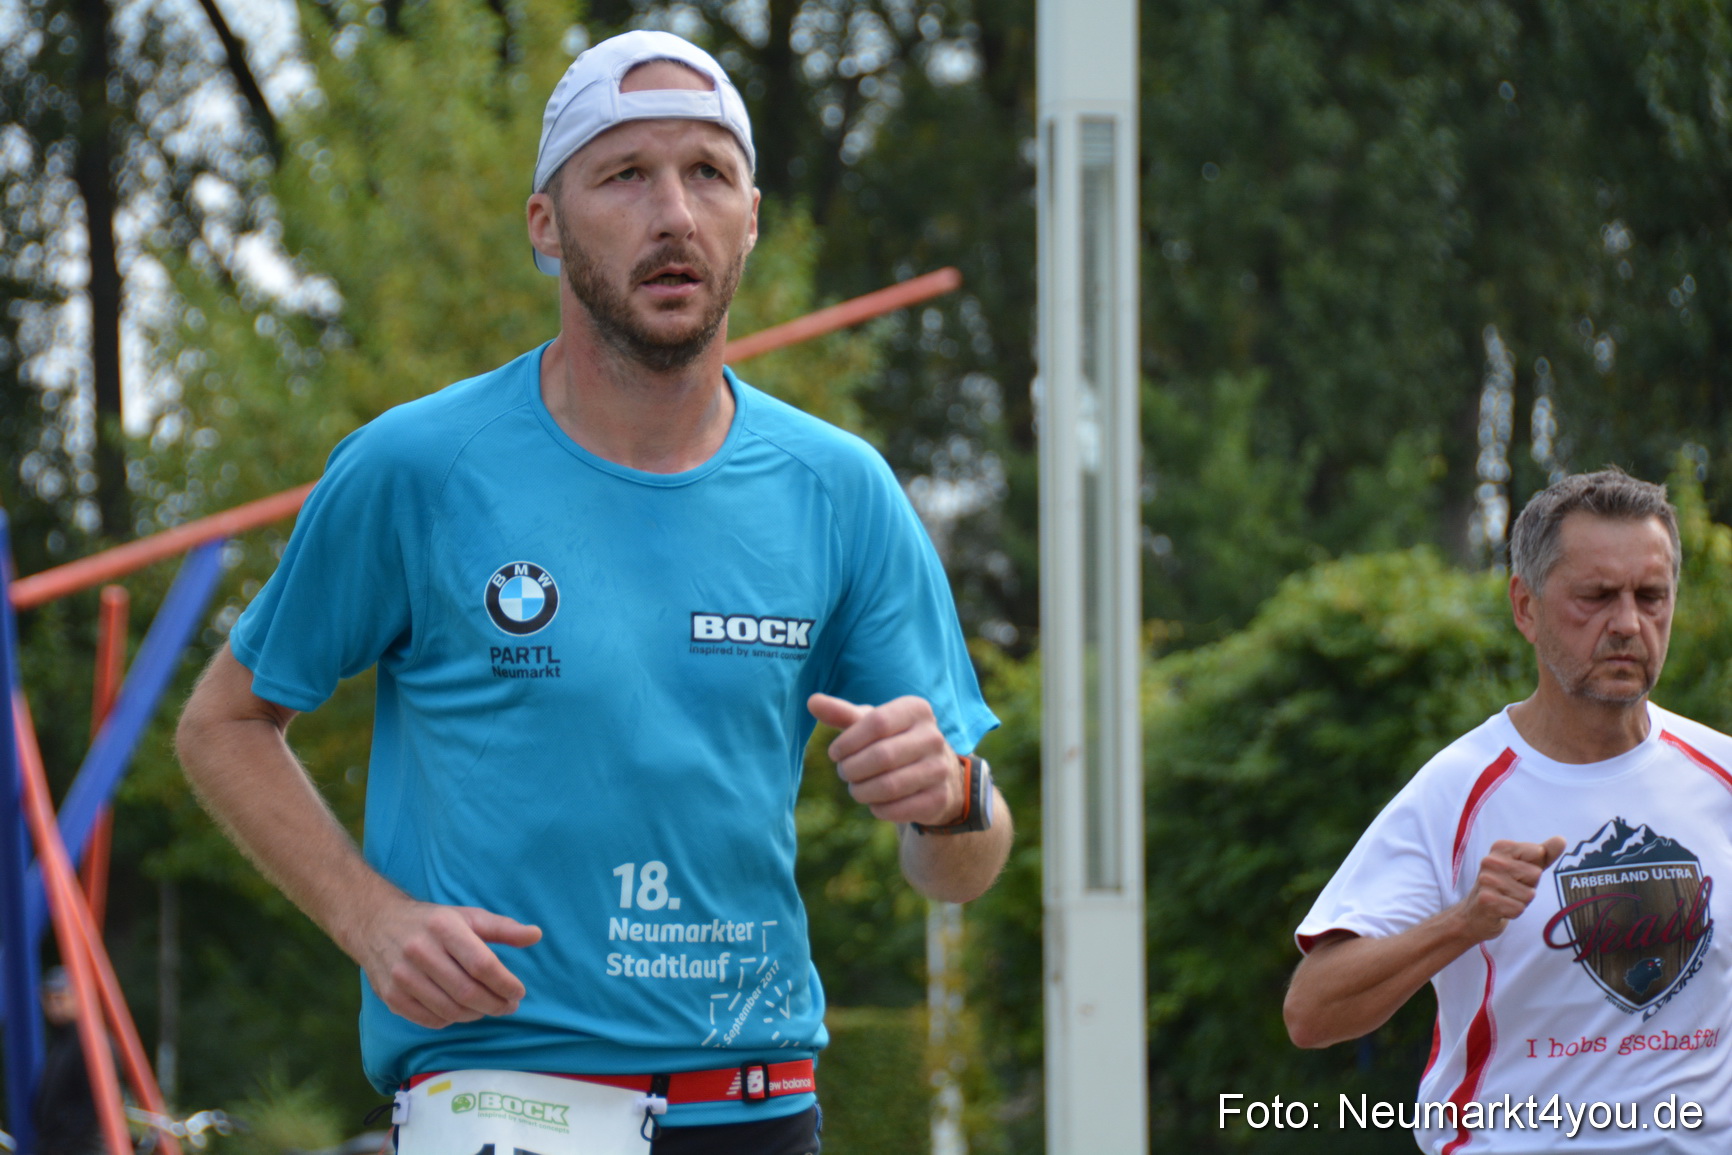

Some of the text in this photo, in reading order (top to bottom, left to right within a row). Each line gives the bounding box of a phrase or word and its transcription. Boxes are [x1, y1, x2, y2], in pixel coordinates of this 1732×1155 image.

[491, 564, 552, 589] BMW
[692, 612, 815, 648] BOCK
[490, 646, 561, 665] PARTL
[689, 645, 733, 656] inspired
[736, 646, 749, 657] by
[752, 649, 779, 658] smart
[492, 665, 561, 679] Neumarkt
[612, 861, 681, 911] 18.
[1570, 866, 1693, 889] ARBERLAND ULTRA
[608, 917, 755, 943] Neumarkter
[1543, 875, 1714, 963] Trail
[606, 952, 731, 983] Stadtlauf
[723, 959, 780, 1045] September 2017
[1526, 1039, 1538, 1058] I
[1547, 1036, 1608, 1058] hobs
[782, 1078, 811, 1090] balance
[477, 1110, 508, 1119] inspired
[478, 1091, 570, 1127] BOCK
